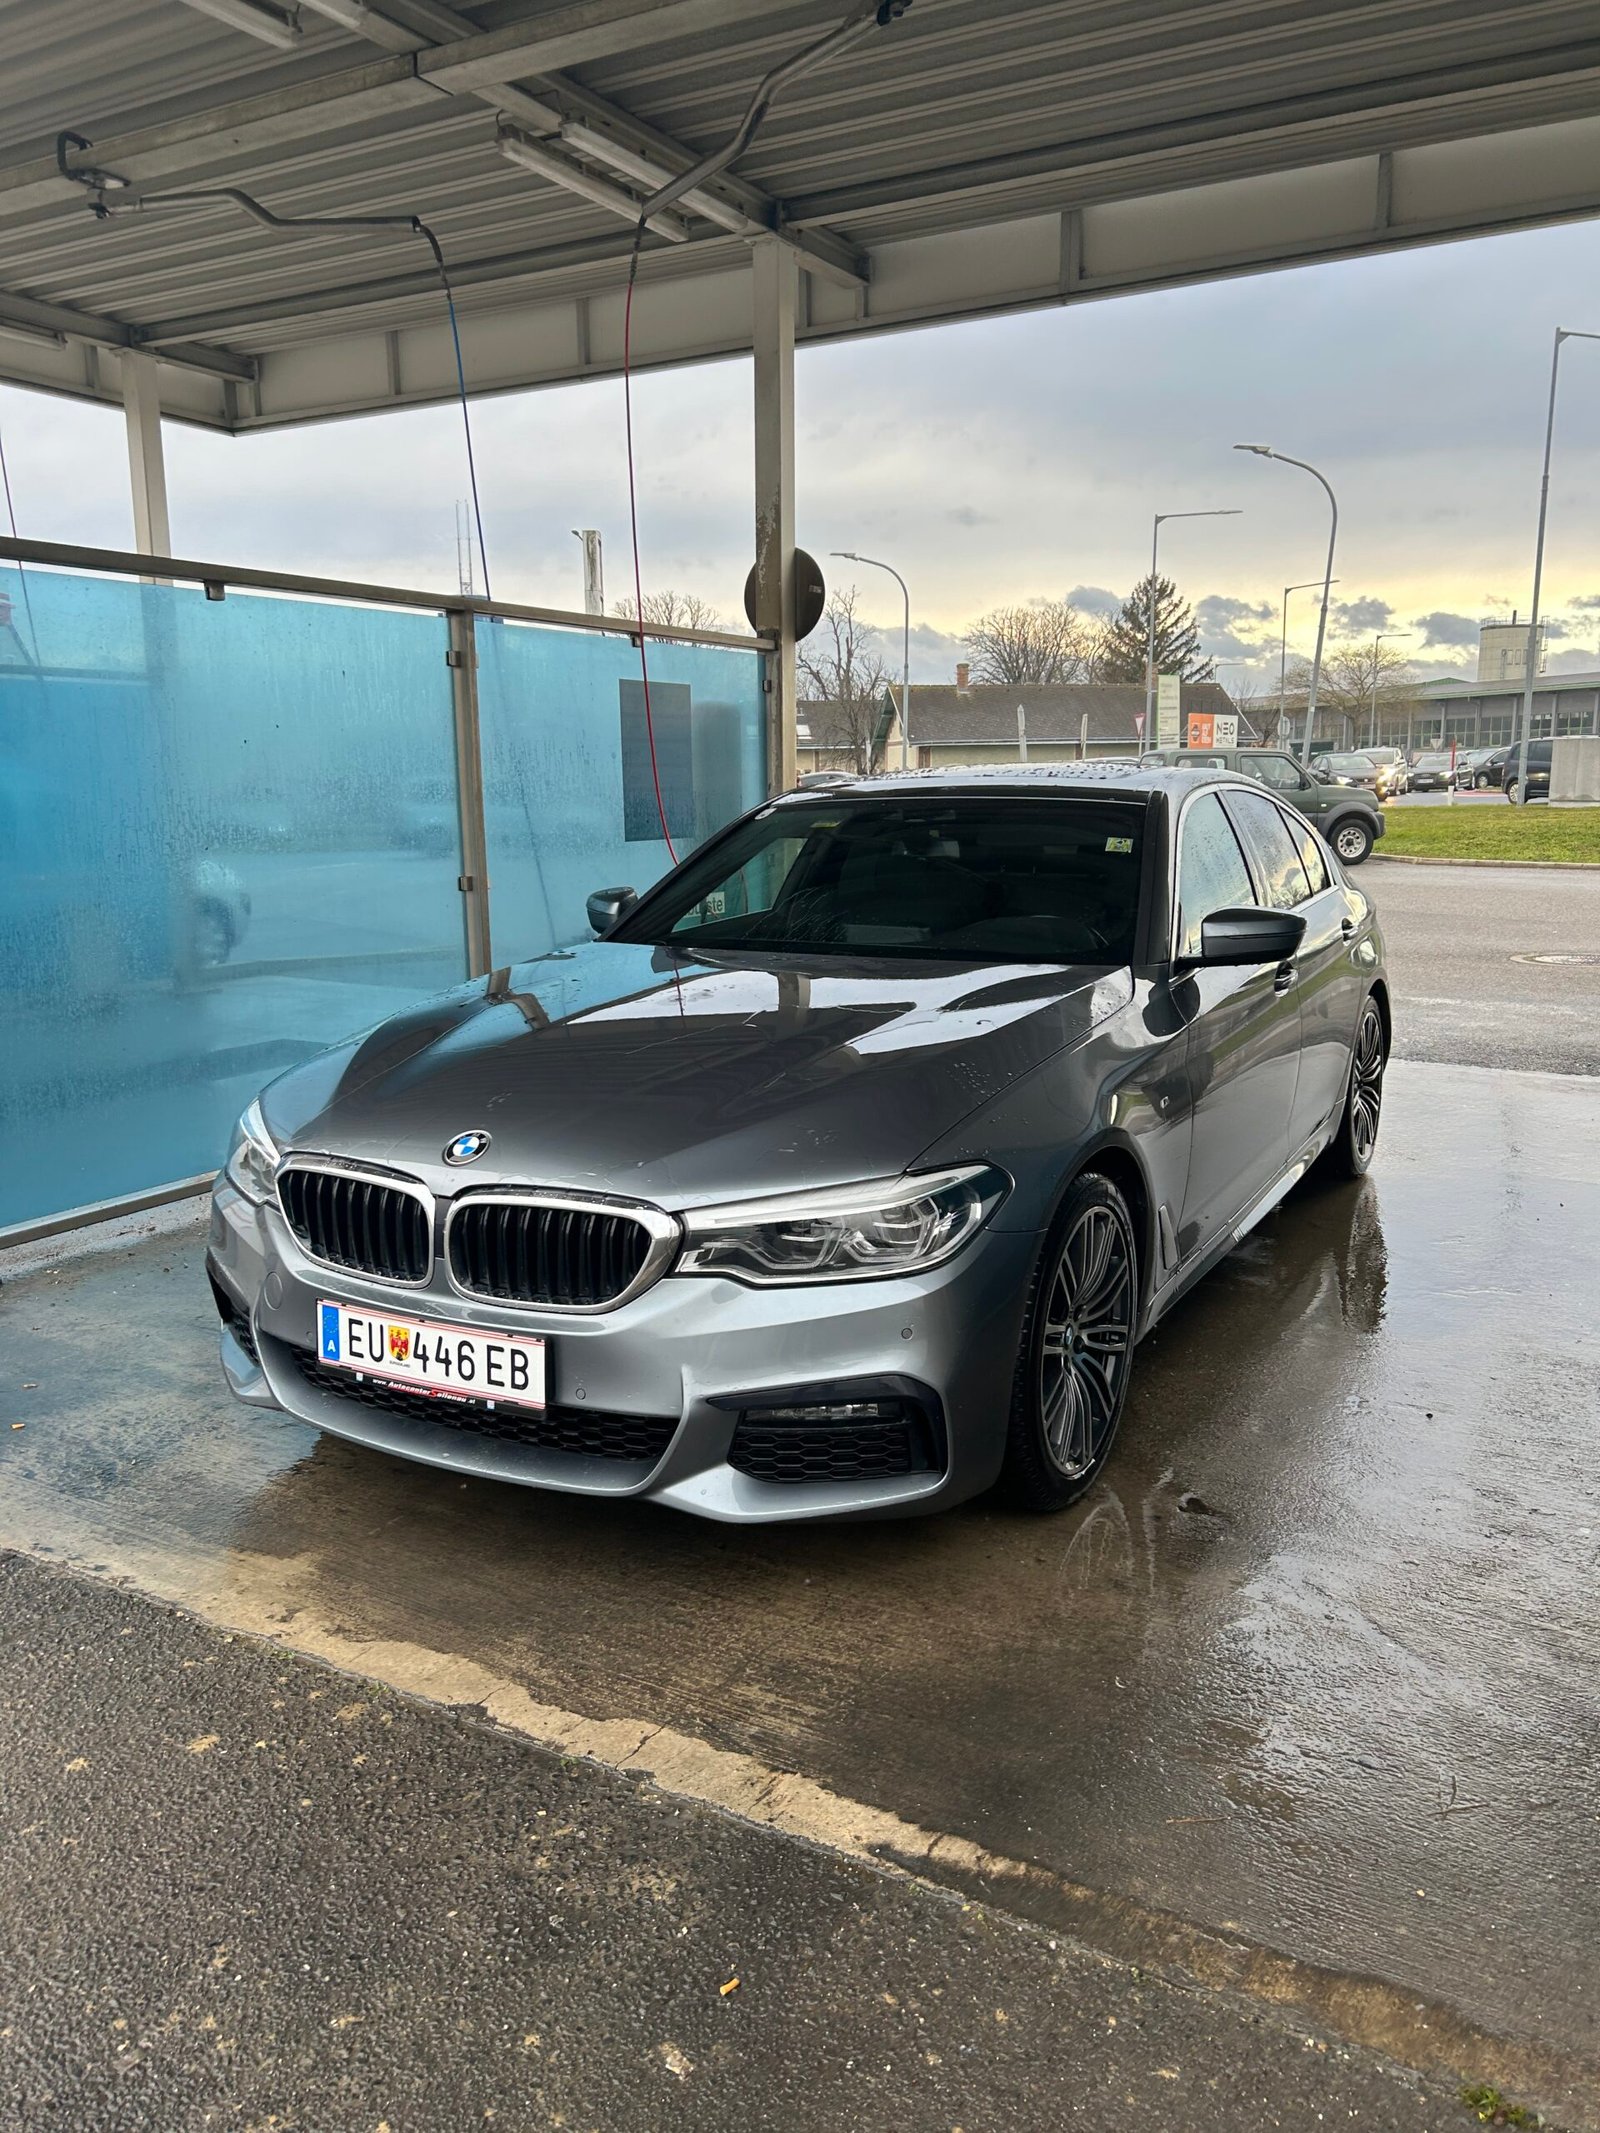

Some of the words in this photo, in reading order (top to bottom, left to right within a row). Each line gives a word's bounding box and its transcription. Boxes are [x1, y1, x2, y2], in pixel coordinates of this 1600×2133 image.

[1216, 721, 1235, 736] NEO
[327, 1339, 336, 1353] A
[348, 1317, 384, 1363] EU
[412, 1331, 476, 1382] 446
[486, 1344, 529, 1391] EB
